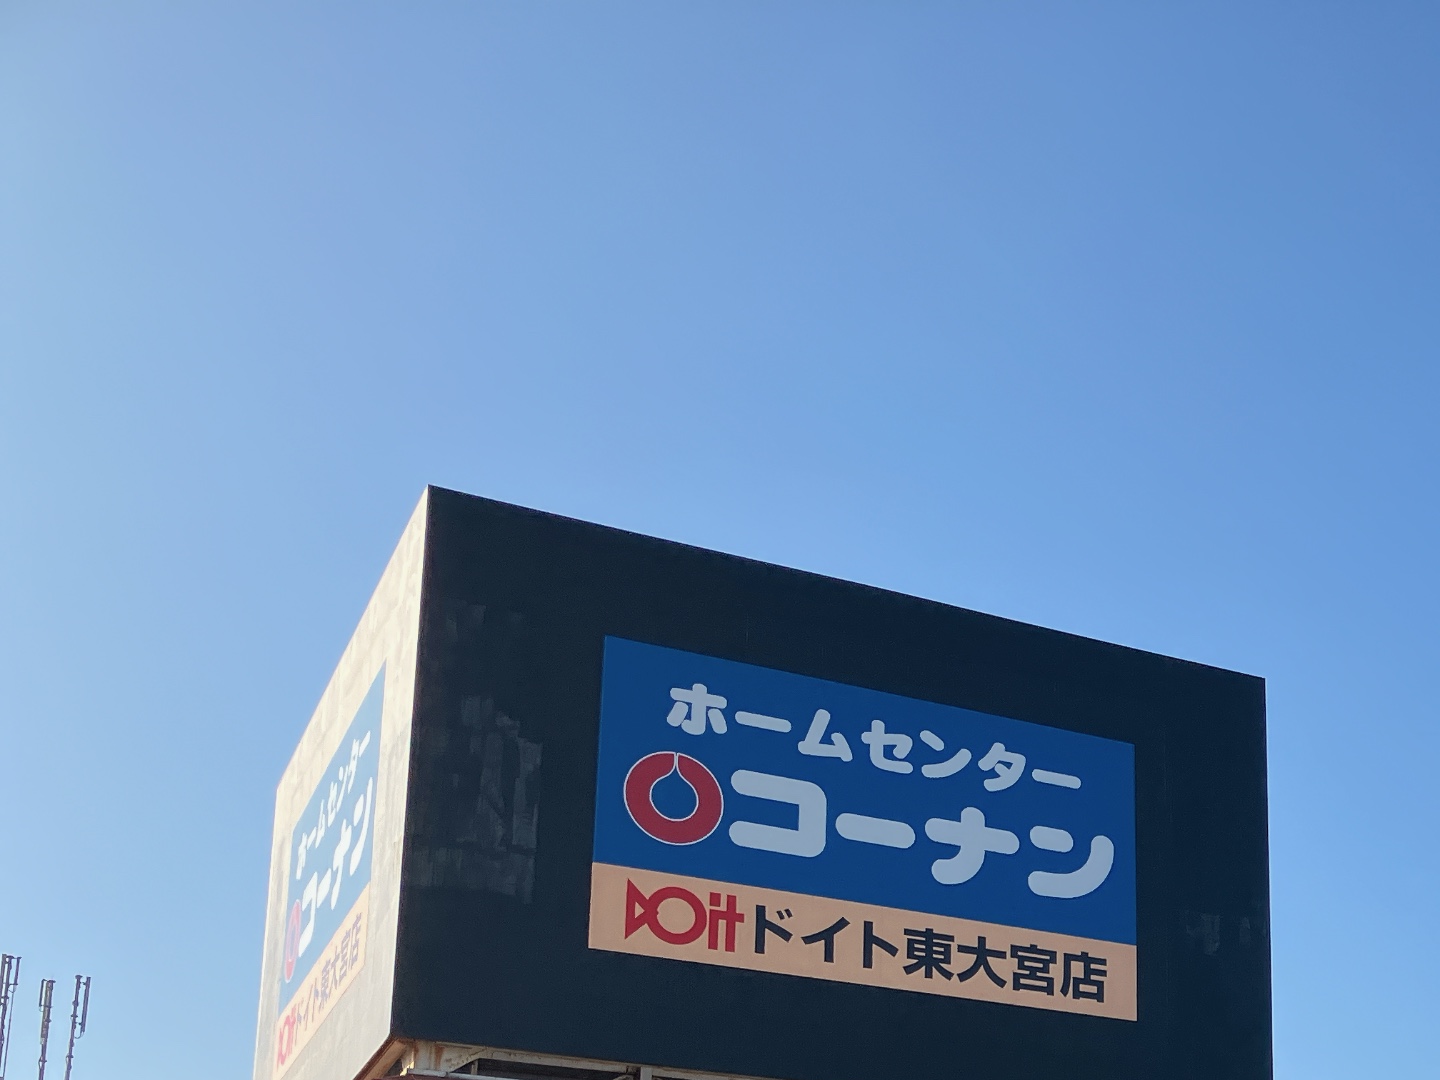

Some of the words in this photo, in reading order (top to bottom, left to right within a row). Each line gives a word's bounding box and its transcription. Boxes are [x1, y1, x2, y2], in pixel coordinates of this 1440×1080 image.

[666, 683, 1082, 792] ホームセンター
[296, 730, 371, 880] ホームセンター
[298, 776, 373, 958] コーナン
[728, 769, 1114, 899] コーナン
[753, 904, 1108, 1003] ドイト東大宮店
